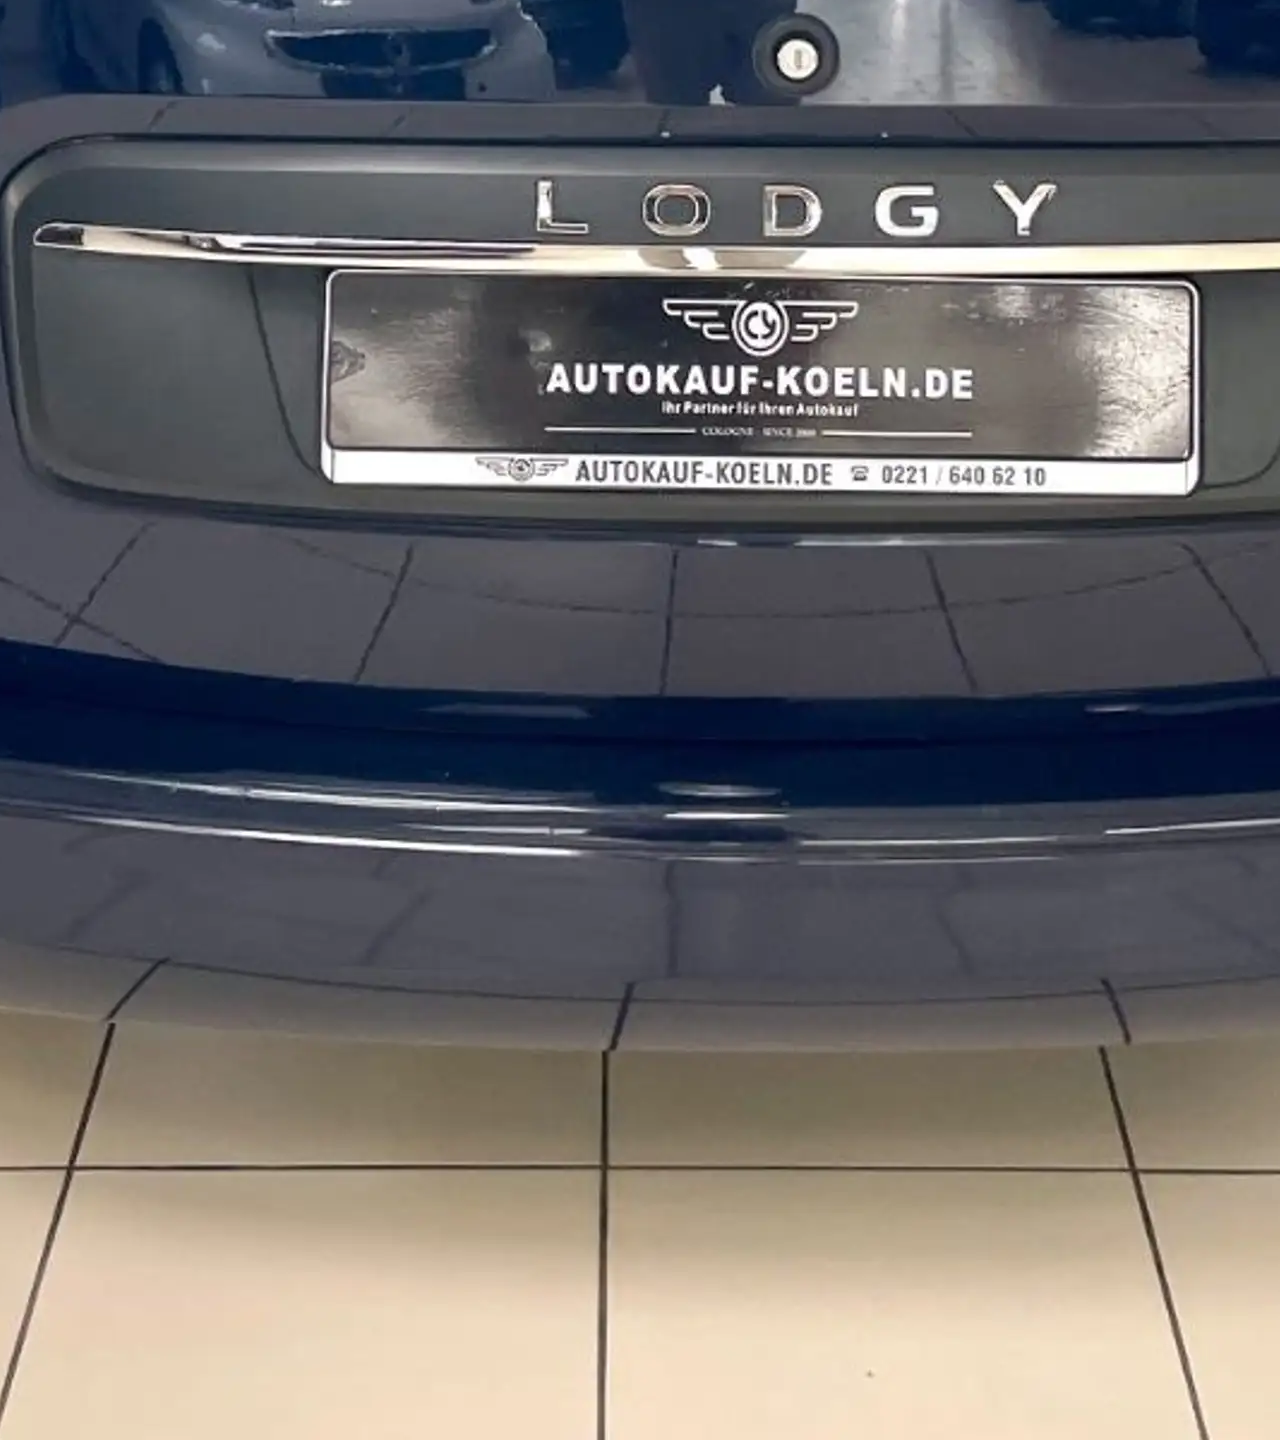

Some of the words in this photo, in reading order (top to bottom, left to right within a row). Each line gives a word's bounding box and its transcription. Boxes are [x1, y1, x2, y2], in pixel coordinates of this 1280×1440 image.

[534, 179, 1058, 237] LODGY
[546, 362, 974, 400] AUTOKAUF-KOELN.DE
[661, 401, 681, 414] Ihr
[683, 400, 734, 415] Partner
[736, 400, 756, 415] für
[759, 401, 794, 416] Ihren
[796, 402, 860, 418] Autokauf
[575, 459, 833, 486] AUTOKAUF-KOELN.DE
[881, 465, 927, 485] 0221
[948, 465, 985, 486] 640
[992, 466, 1016, 487] 62
[1025, 467, 1046, 487] 10
